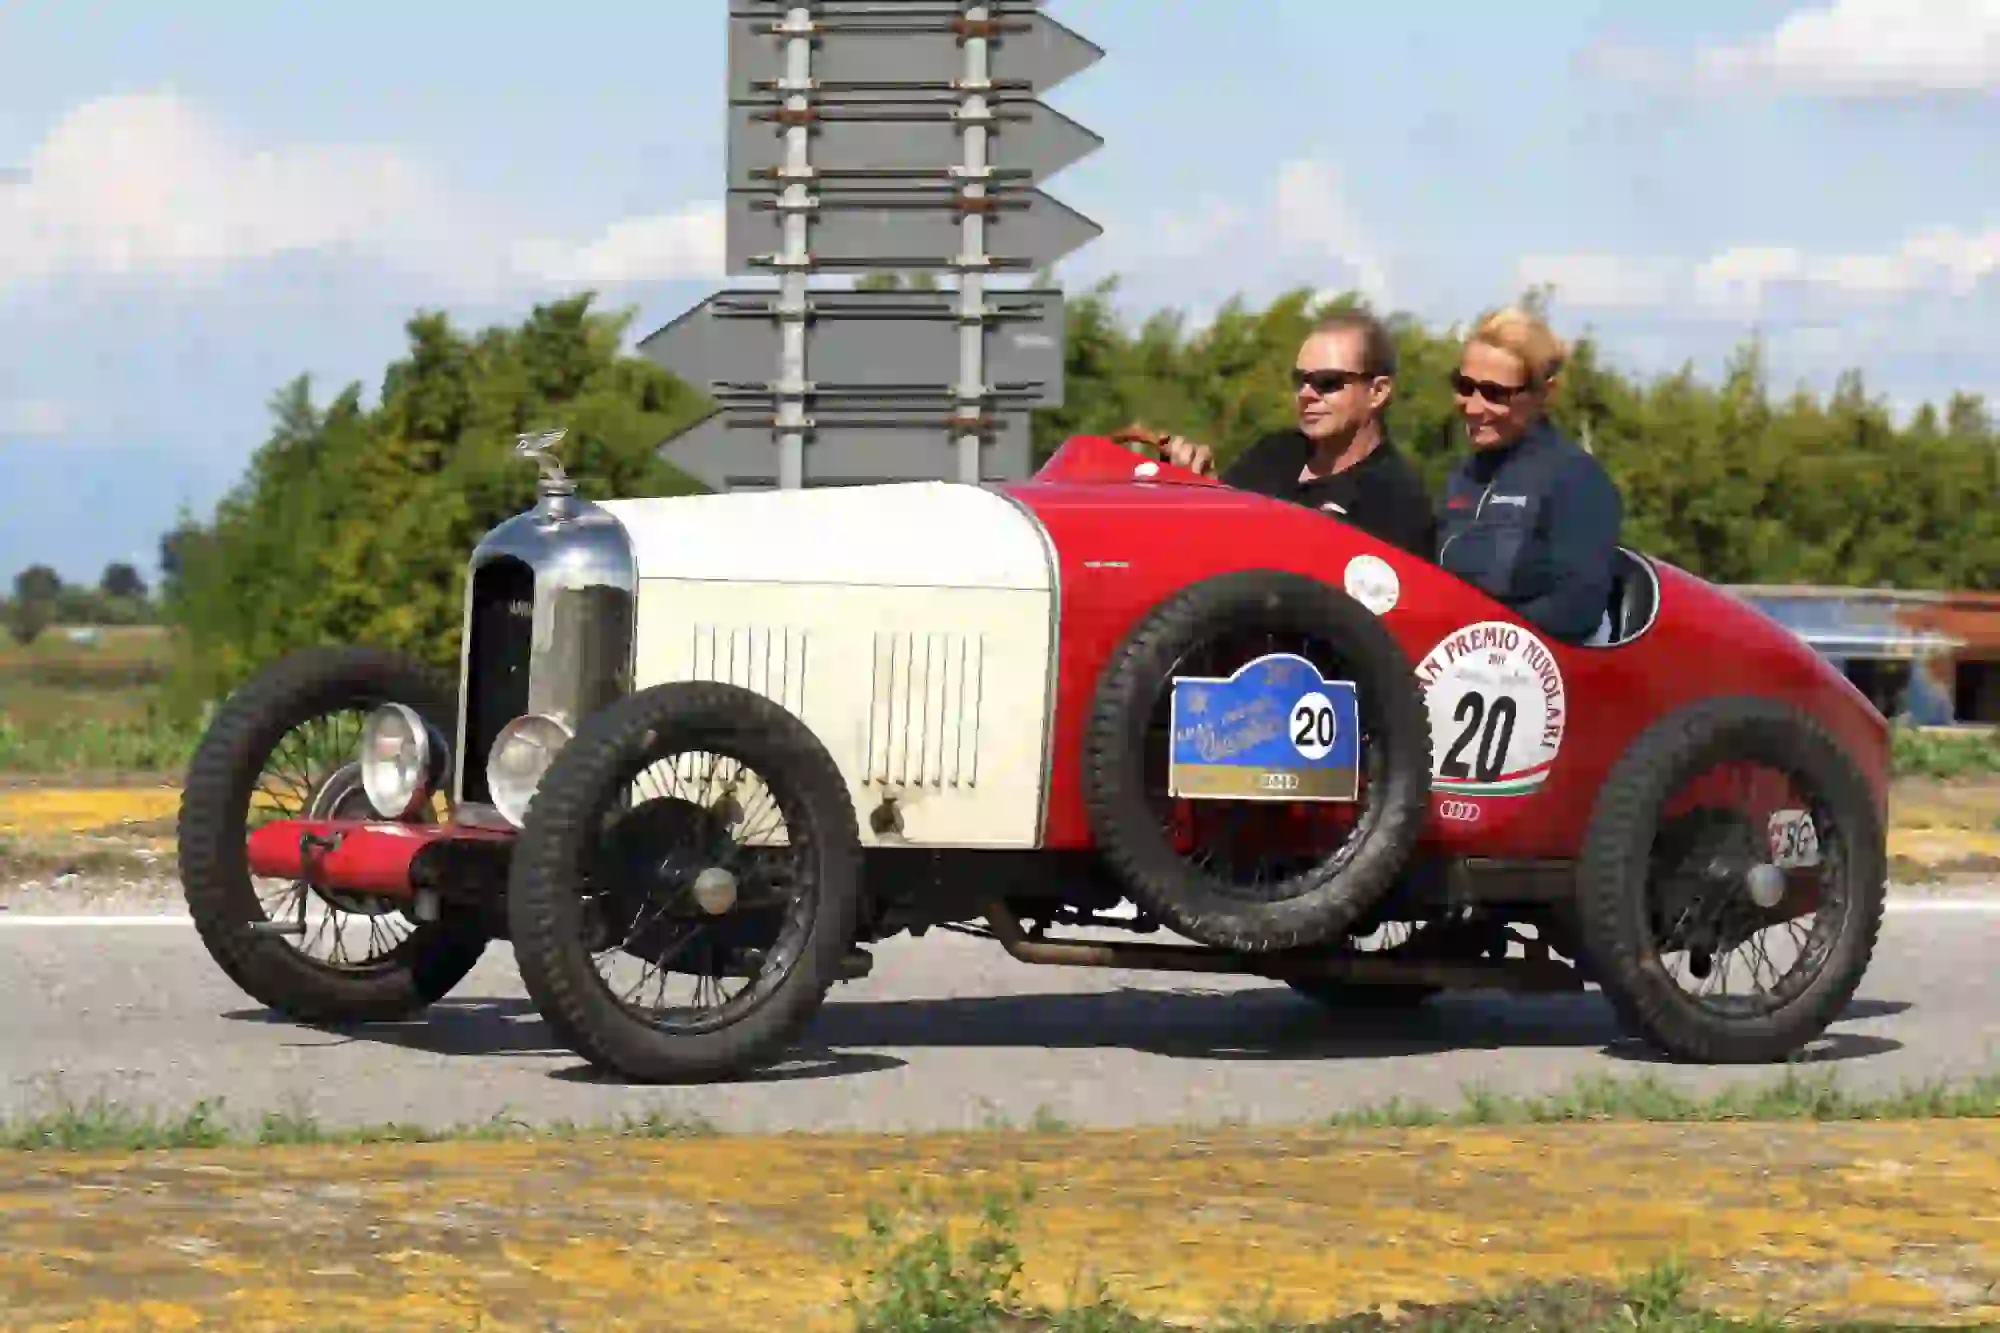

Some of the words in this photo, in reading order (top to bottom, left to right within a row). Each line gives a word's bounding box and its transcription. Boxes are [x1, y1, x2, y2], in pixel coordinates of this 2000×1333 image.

[1295, 707, 1333, 747] 20
[1444, 627, 1519, 664] PREMIO
[1522, 640, 1561, 749] NUVOLARI
[1440, 691, 1516, 782] 20
